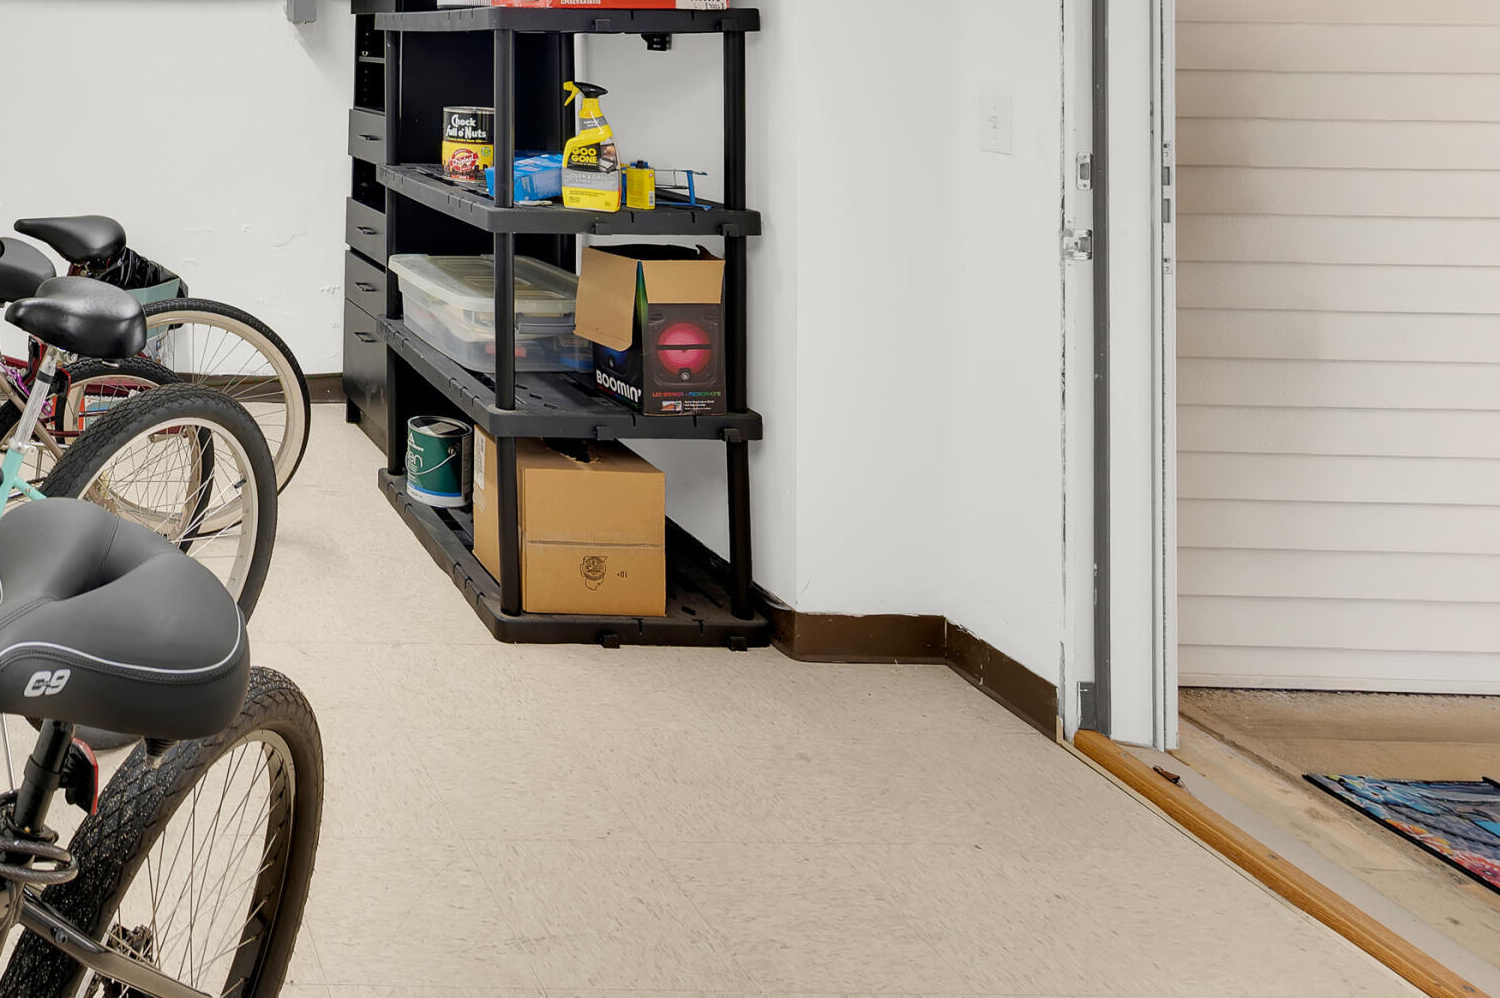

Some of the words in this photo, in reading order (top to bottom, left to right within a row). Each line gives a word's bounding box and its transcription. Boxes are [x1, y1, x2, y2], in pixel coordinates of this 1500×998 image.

[451, 113, 476, 128] Chock
[571, 147, 597, 156] GOO
[571, 154, 598, 164] GONE
[23, 668, 71, 698] C9
